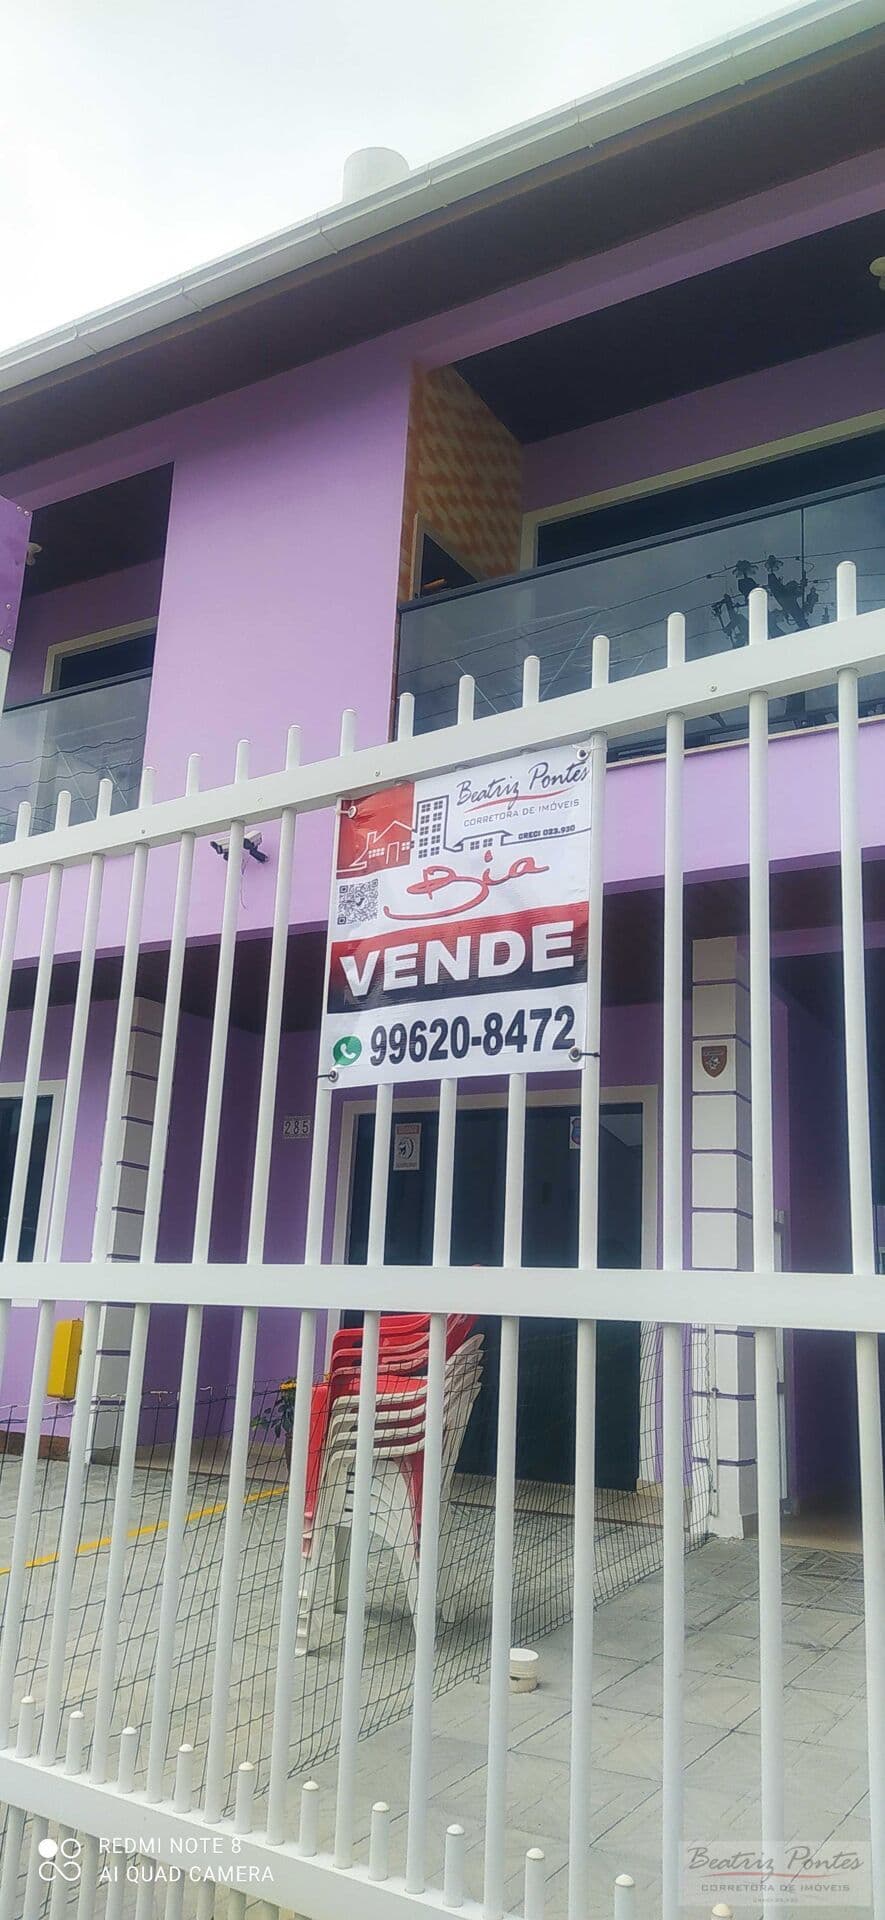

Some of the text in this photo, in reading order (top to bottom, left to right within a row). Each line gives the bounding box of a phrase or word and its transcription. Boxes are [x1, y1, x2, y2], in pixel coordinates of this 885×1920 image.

[456, 761, 590, 810] Beatriz Pontes
[463, 798, 580, 828] CORRETORA DE IMÓVEIS
[517, 830, 541, 840] CRECI
[383, 850, 549, 921] Bia
[339, 920, 575, 998] VENDE
[370, 1005, 576, 1067] 99620-8472
[284, 1119, 310, 1136] 285
